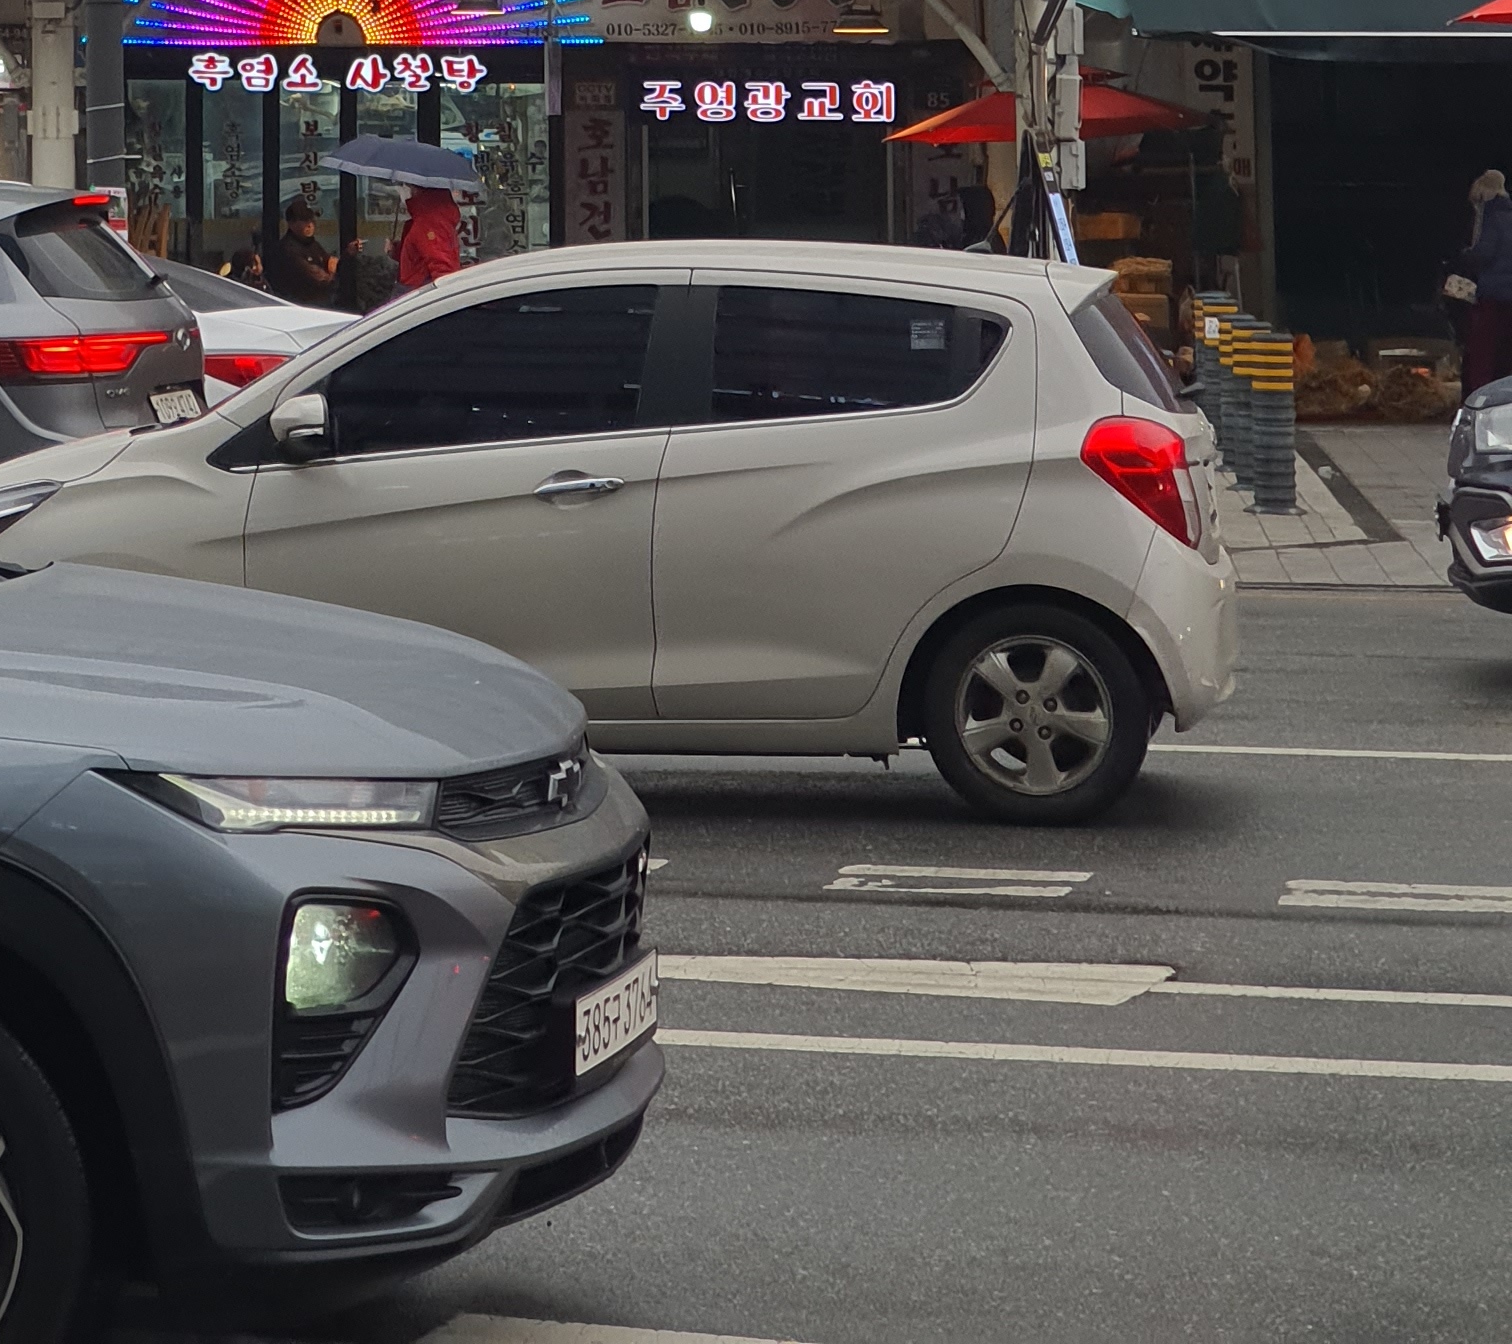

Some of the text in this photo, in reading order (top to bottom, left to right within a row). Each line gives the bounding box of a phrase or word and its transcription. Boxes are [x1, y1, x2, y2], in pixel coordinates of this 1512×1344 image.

[188, 52, 488, 94] 흑염소 사철탕
[639, 79, 896, 123] 주영광교회
[581, 965, 653, 1062] 385구 3764
